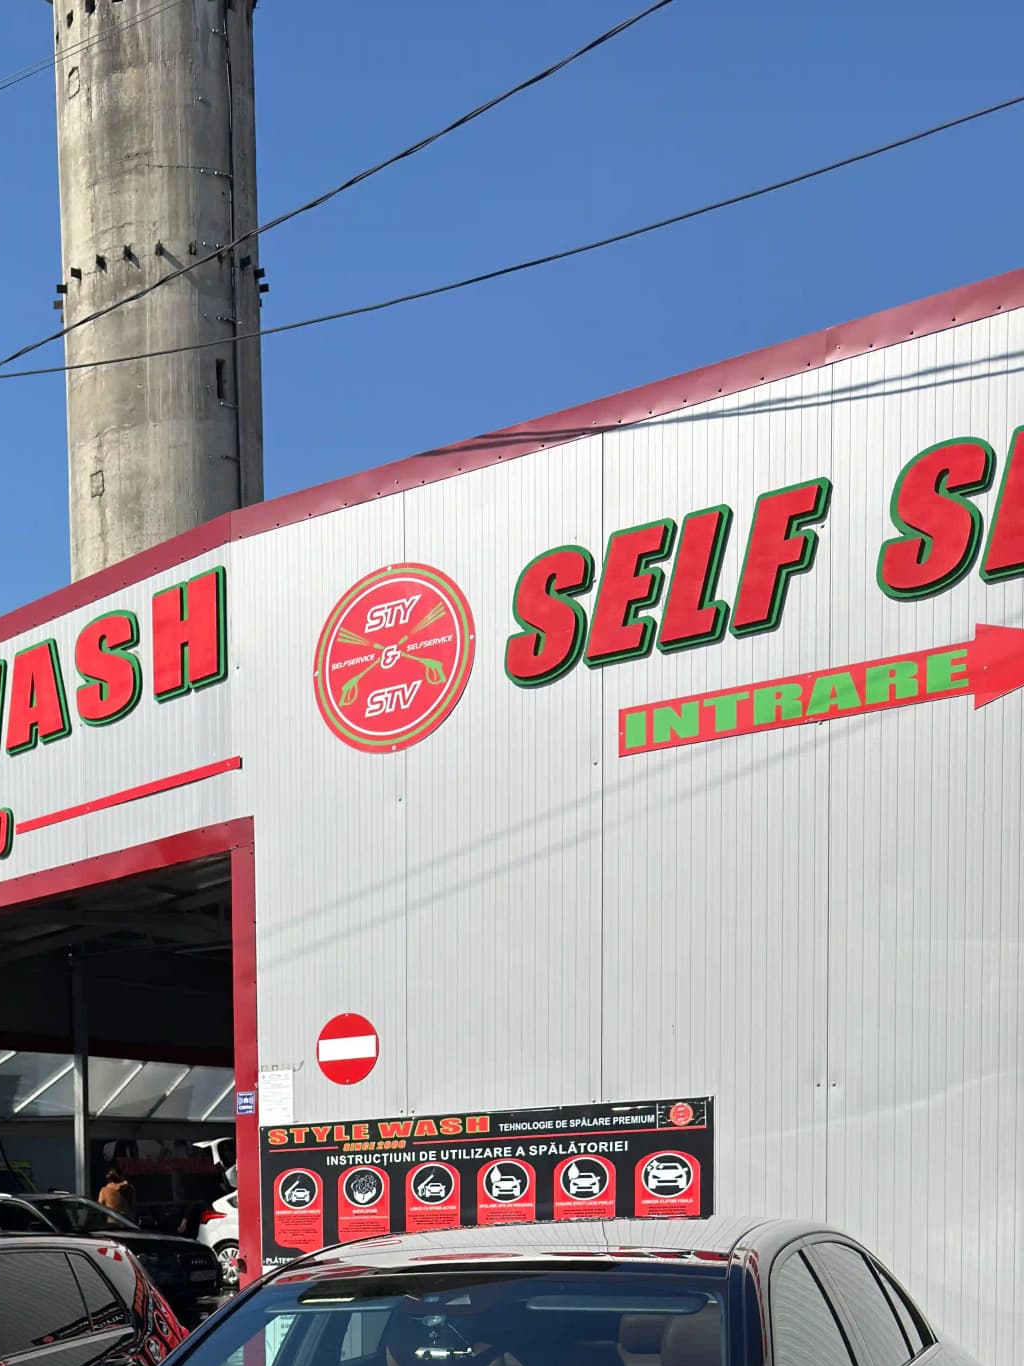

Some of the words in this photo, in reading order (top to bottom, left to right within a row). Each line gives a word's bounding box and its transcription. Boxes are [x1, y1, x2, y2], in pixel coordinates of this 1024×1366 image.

[505, 477, 832, 689] SELF
[364, 594, 422, 633] STY
[380, 645, 401, 669] &
[406, 634, 453, 652] SELFSERVICE
[364, 680, 422, 718] STV
[625, 648, 969, 749] INTRARE
[268, 1123, 370, 1145] STYLE
[377, 1116, 490, 1139] WASH
[499, 1121, 553, 1132] TEHNOLOGIE
[555, 1119, 568, 1129] DE
[612, 1114, 655, 1126] PREMIUM
[419, 1151, 437, 1161] DE
[441, 1146, 512, 1161] UTILIZARE
[516, 1147, 525, 1156] A
